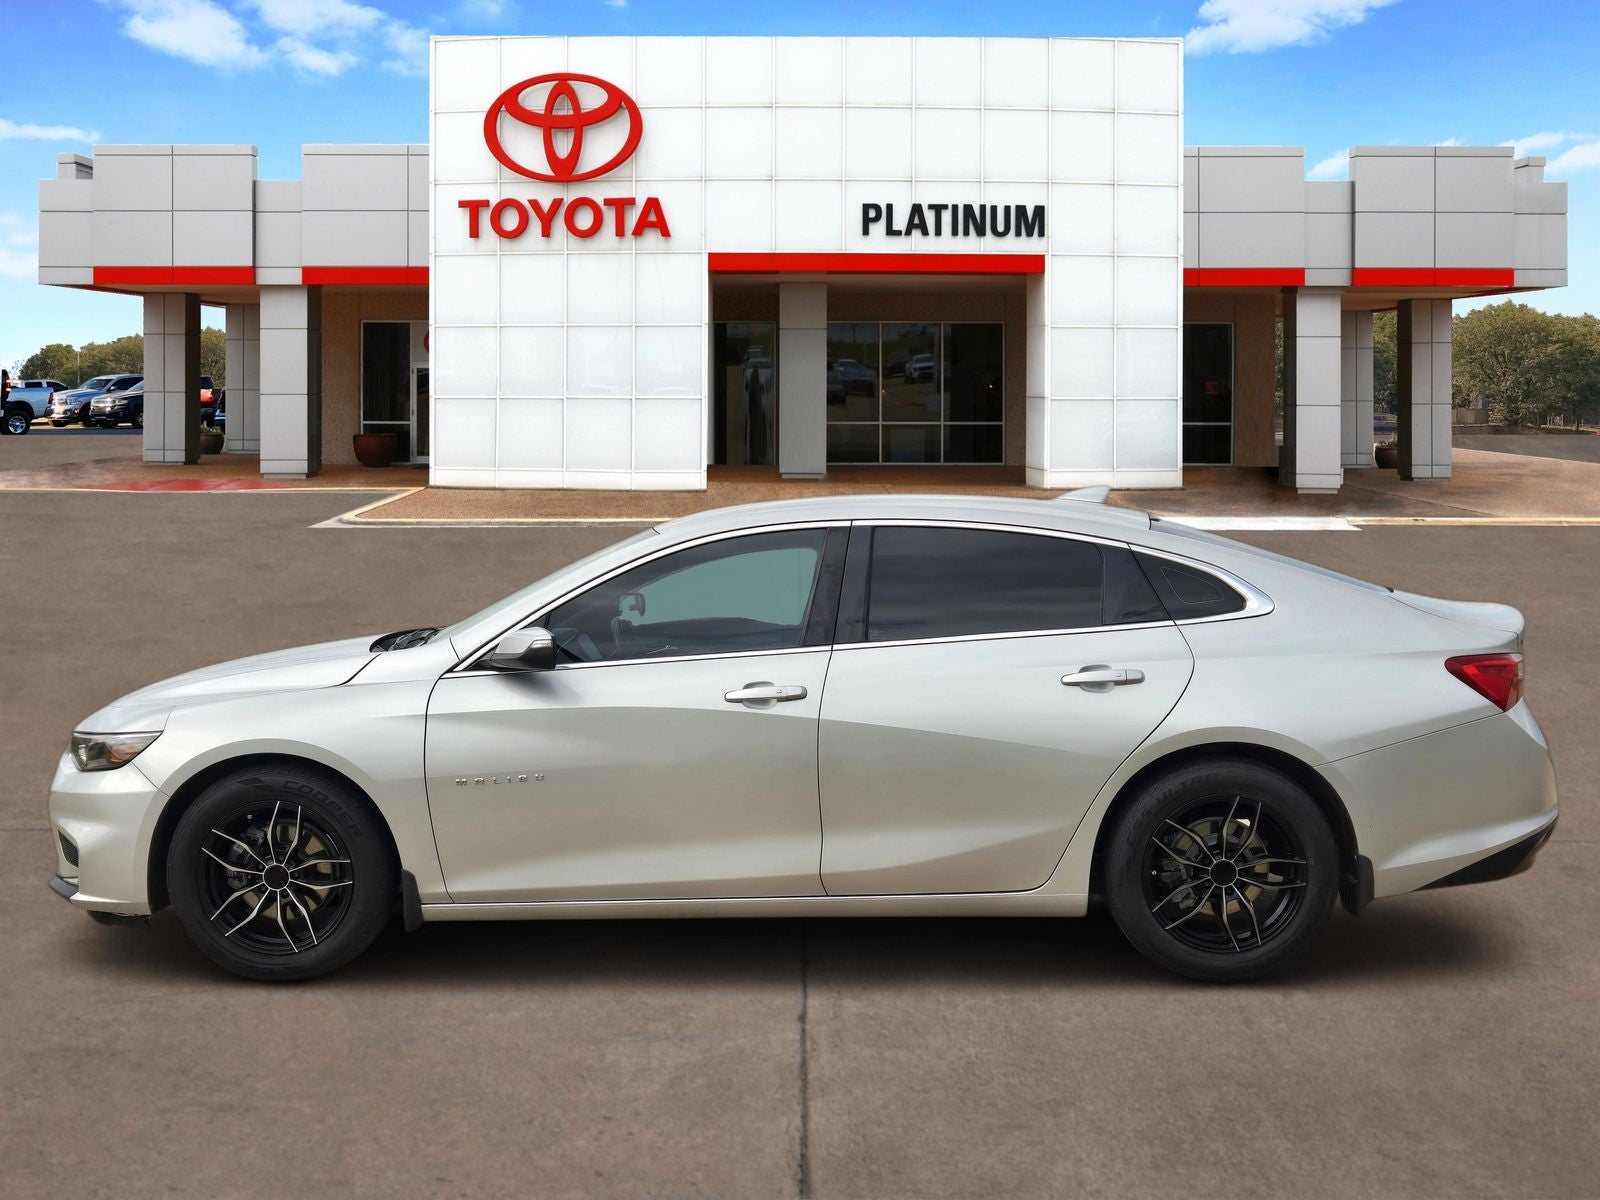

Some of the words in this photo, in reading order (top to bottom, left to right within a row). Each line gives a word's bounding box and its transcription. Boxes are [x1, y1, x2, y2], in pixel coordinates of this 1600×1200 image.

[458, 197, 671, 239] TOYOTA
[862, 203, 1046, 238] PLATINUM
[455, 773, 545, 786] MALIBU
[283, 780, 362, 836] COOPER
